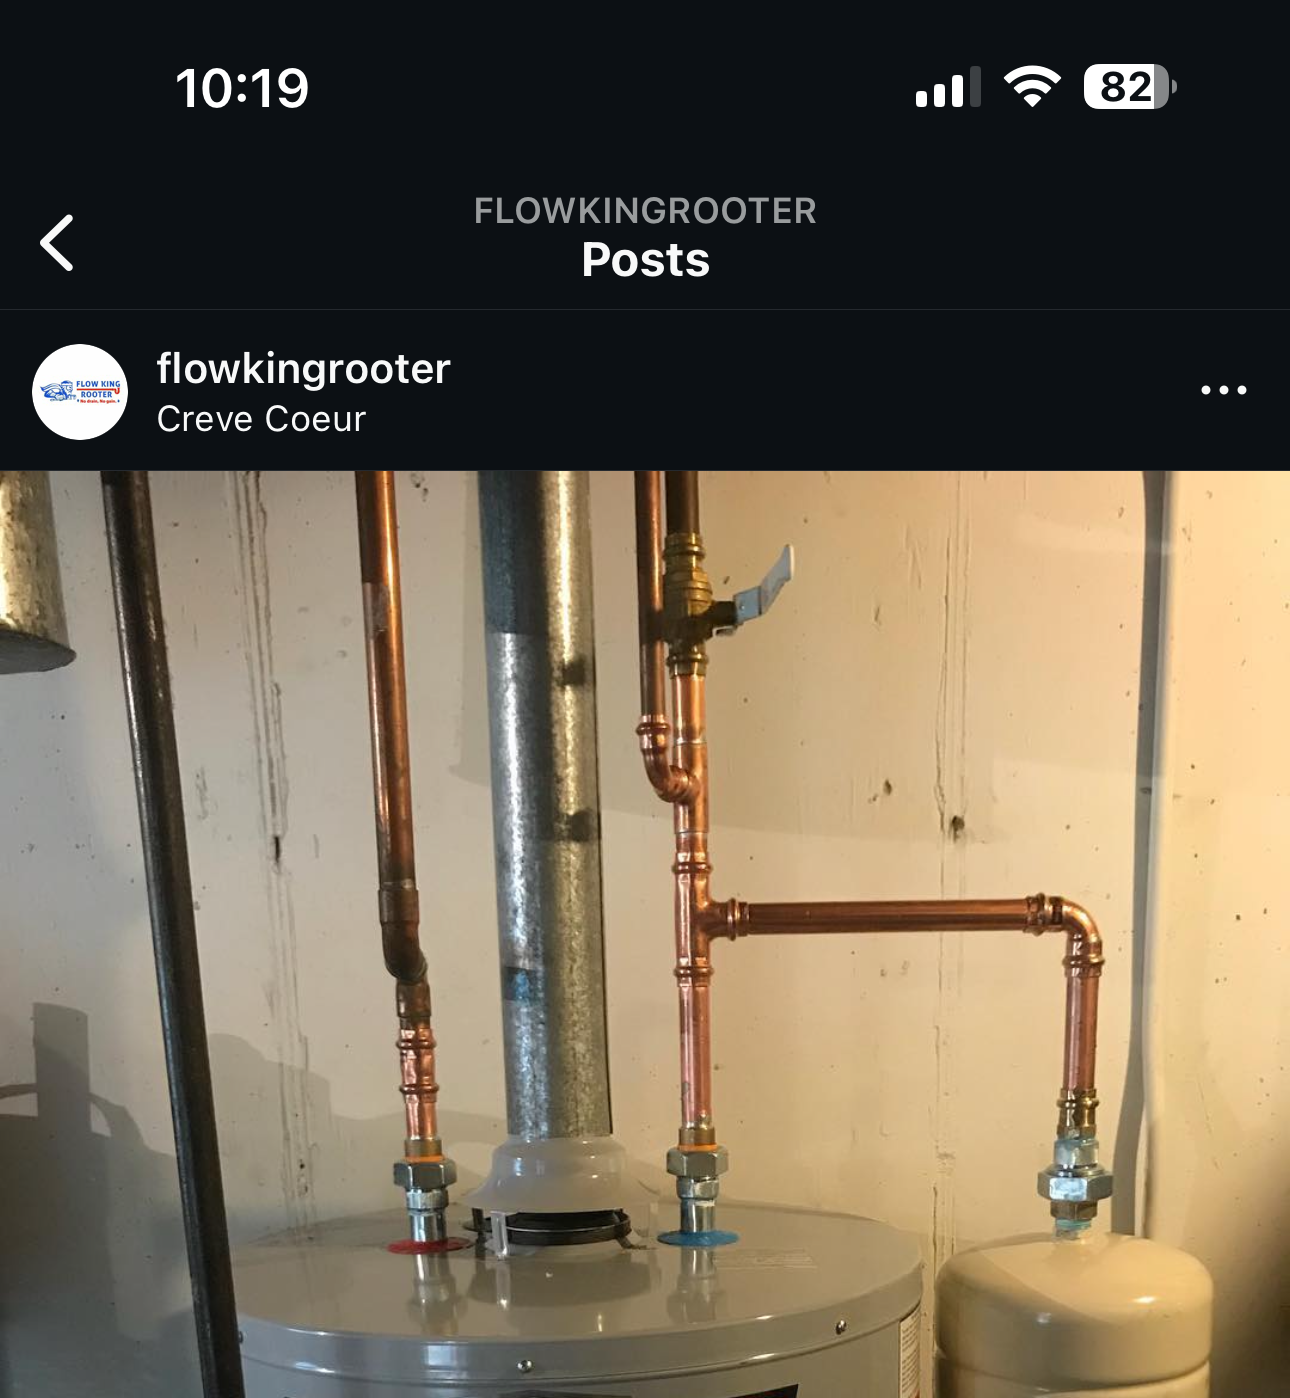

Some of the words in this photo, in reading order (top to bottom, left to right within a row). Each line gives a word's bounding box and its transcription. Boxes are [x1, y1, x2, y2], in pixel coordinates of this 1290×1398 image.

[177, 68, 308, 108] 10:19
[1101, 71, 1151, 102] 82
[475, 196, 817, 225] FLOWKINGROOTER
[583, 241, 710, 278] Posts
[76, 380, 99, 388] FLOW
[101, 380, 121, 388] KING
[156, 350, 452, 392] flowkingrooter
[157, 404, 253, 433] Creve
[265, 404, 367, 433] Coeur
